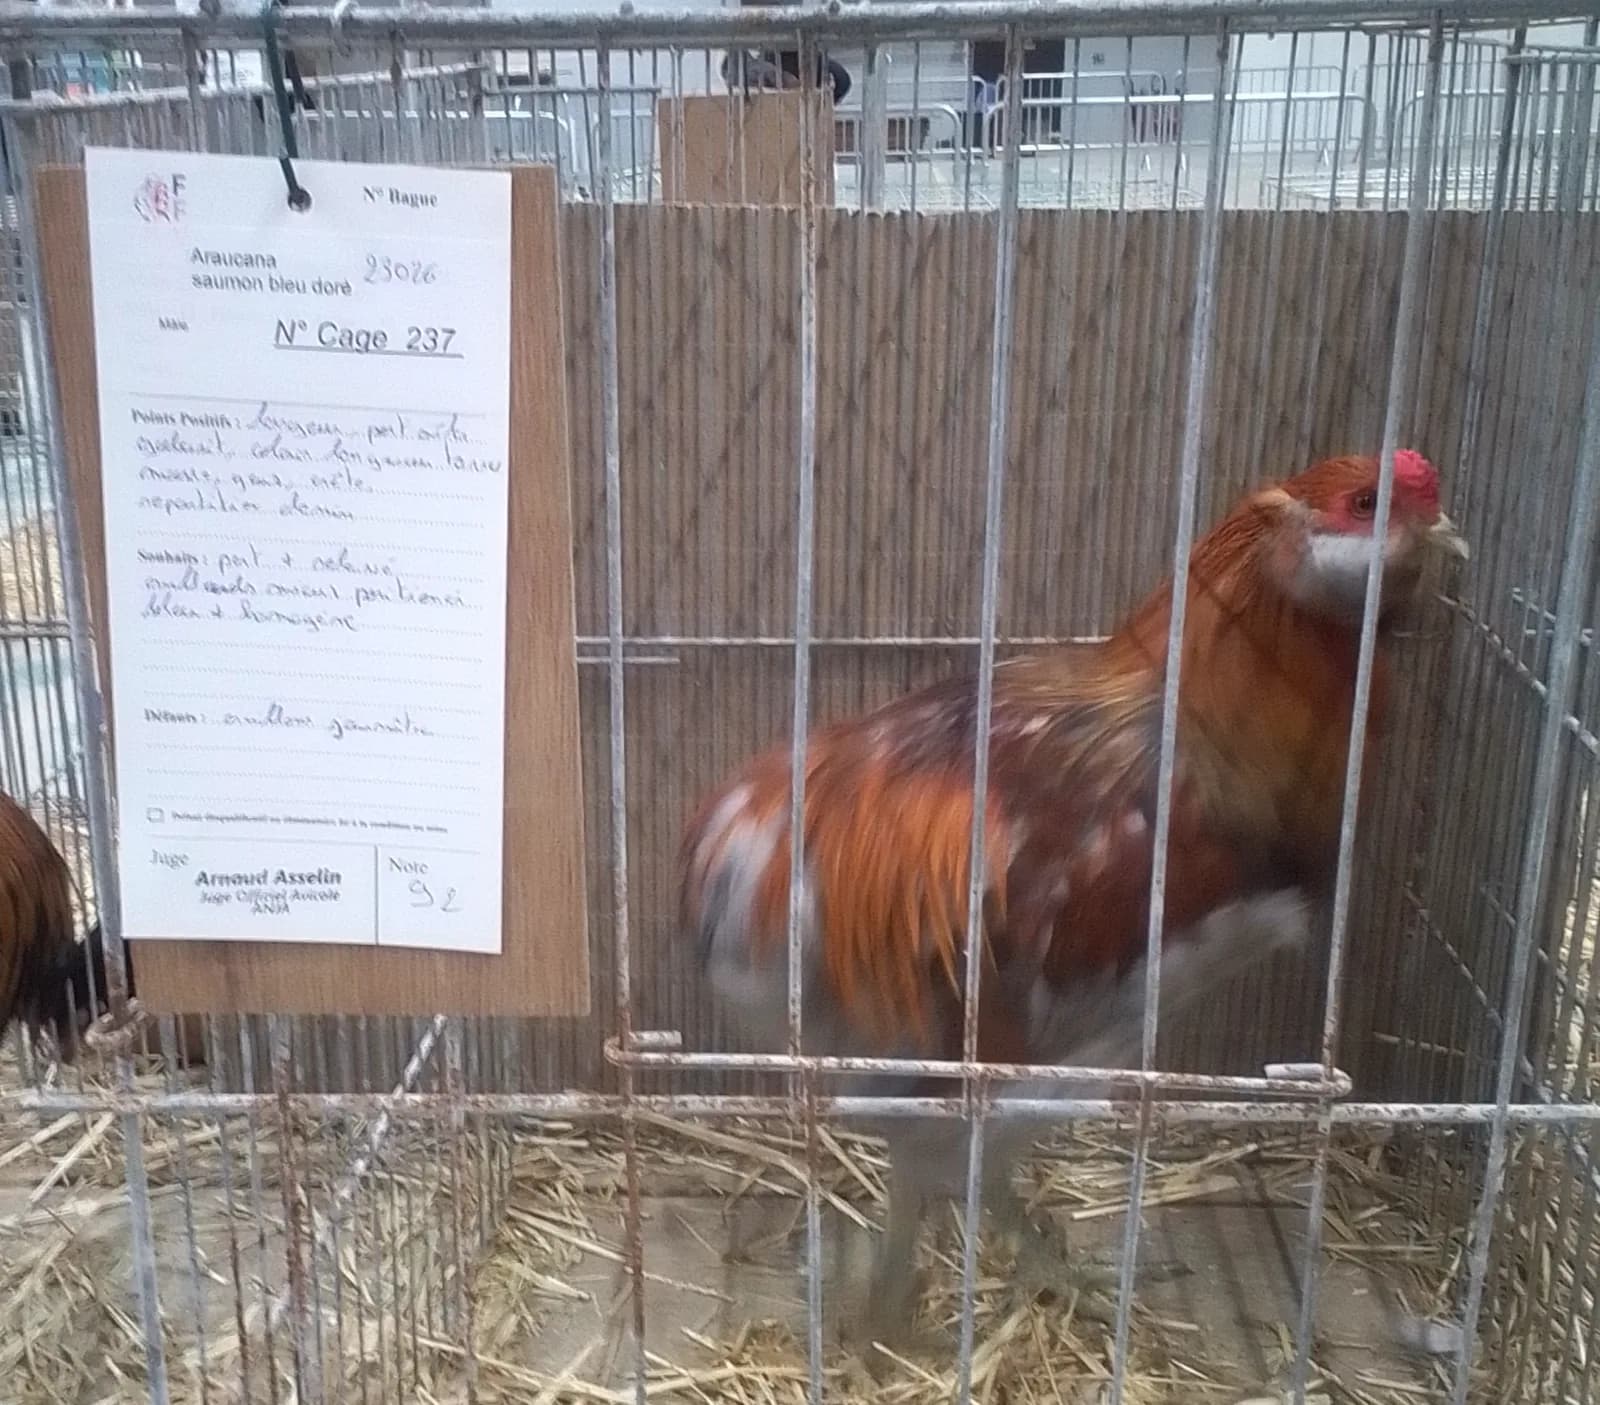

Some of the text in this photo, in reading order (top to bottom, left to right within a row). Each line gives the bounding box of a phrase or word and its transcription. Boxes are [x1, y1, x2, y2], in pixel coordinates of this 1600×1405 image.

[389, 187, 438, 208] Bague
[191, 248, 276, 269] Araucana
[192, 273, 353, 297] saumon bleu doré
[274, 319, 456, 353] N° Cage 237
[150, 848, 190, 870] Juge
[389, 855, 429, 874] Note
[195, 867, 342, 888] Arnaud Asselin
